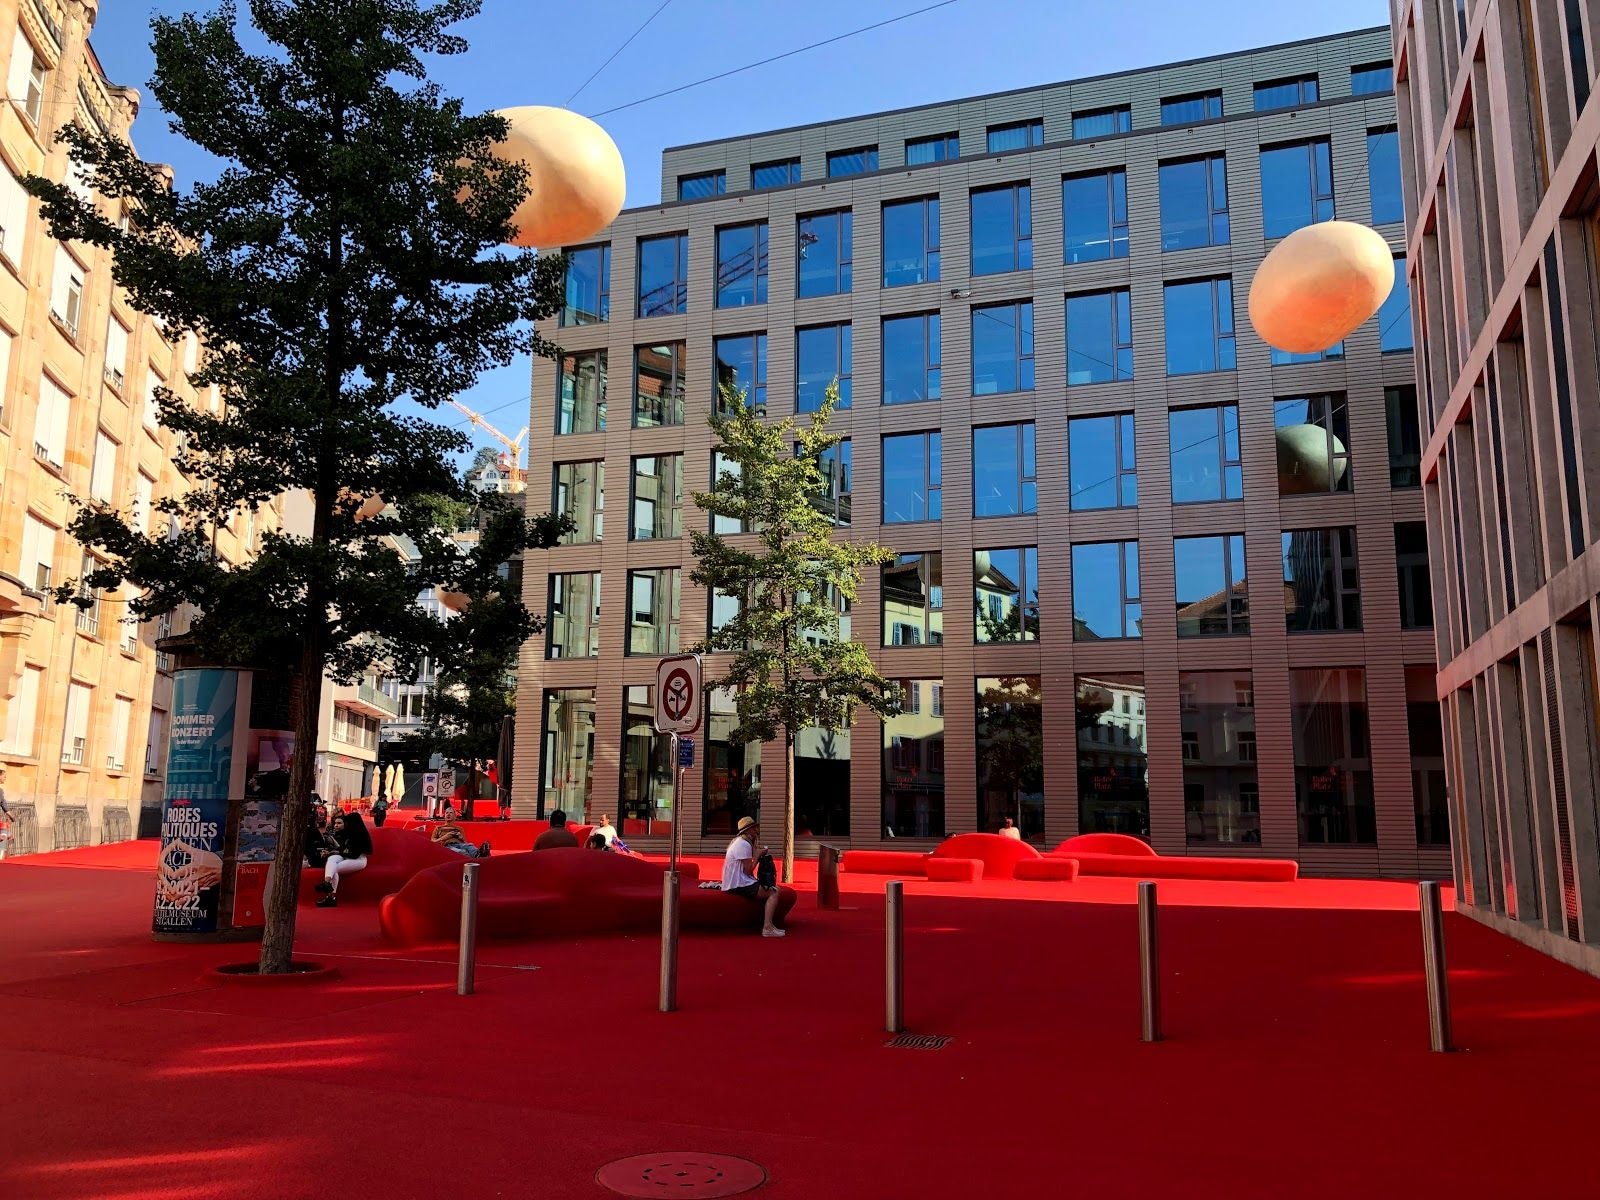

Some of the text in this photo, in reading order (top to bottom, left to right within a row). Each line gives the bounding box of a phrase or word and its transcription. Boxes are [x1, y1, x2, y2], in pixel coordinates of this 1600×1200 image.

[173, 714, 215, 725] SOMMER
[167, 807, 201, 823] ROBES
[161, 822, 218, 838] POLITIQUES
